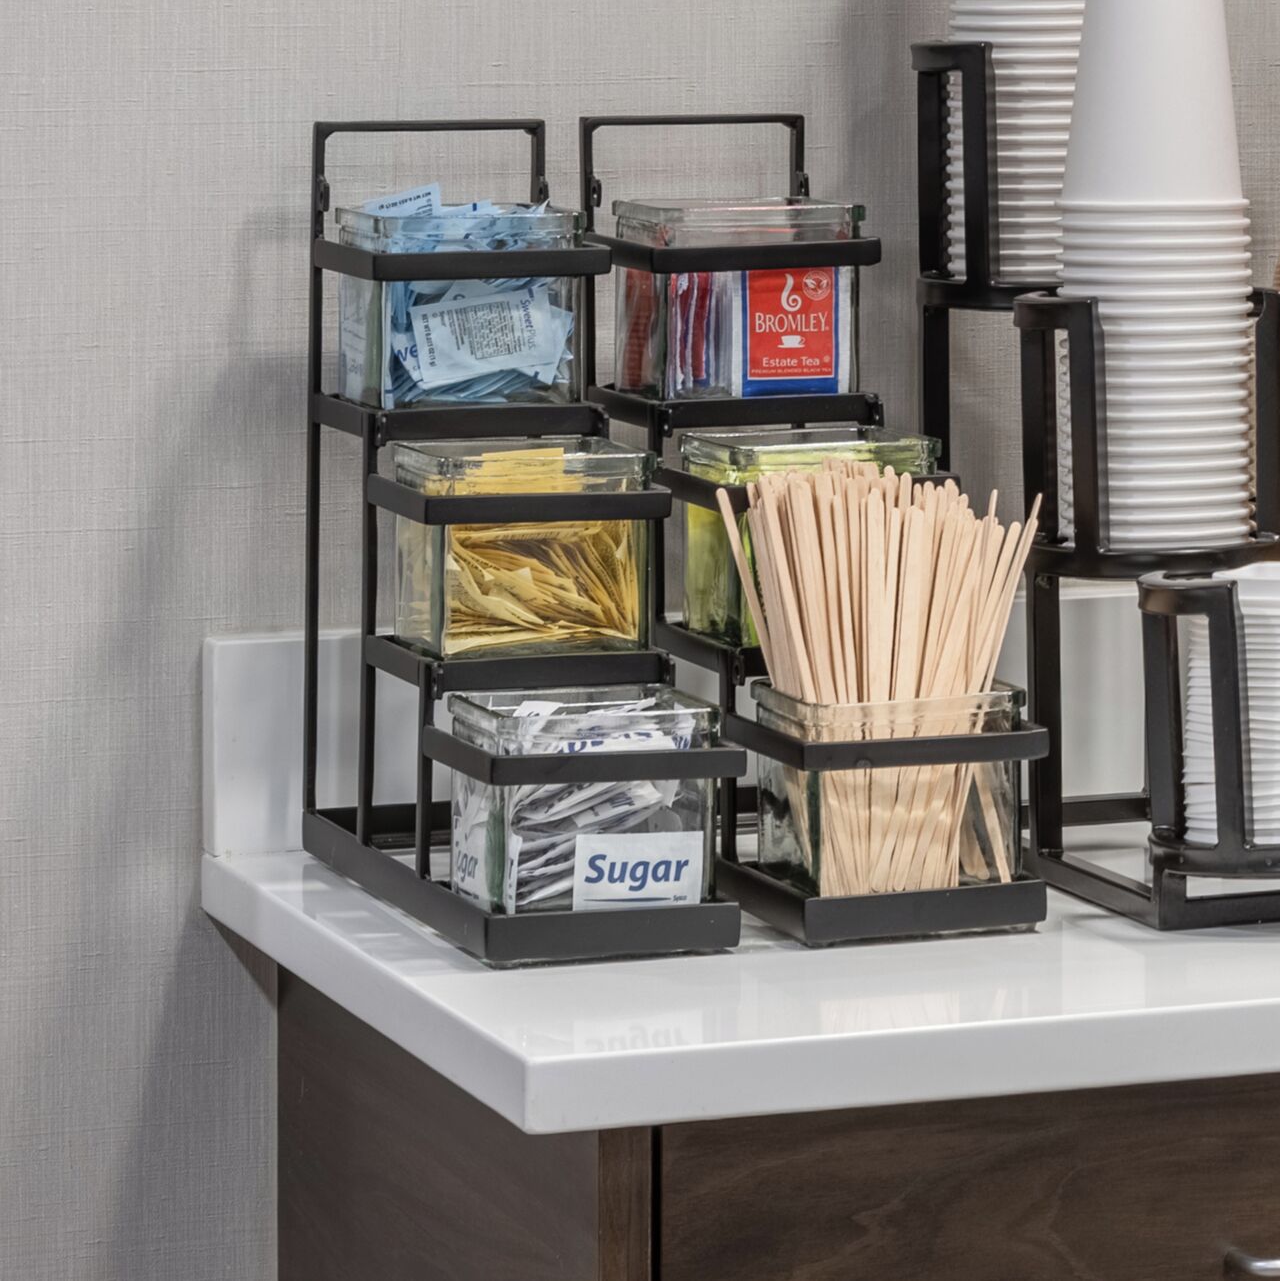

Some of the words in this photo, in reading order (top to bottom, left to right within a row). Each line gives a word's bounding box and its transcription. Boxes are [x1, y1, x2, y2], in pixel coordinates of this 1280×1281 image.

[755, 312, 827, 333] BROMLEY
[762, 357, 798, 367] Estate
[800, 356, 820, 367] Tea
[584, 854, 690, 892] Sugar
